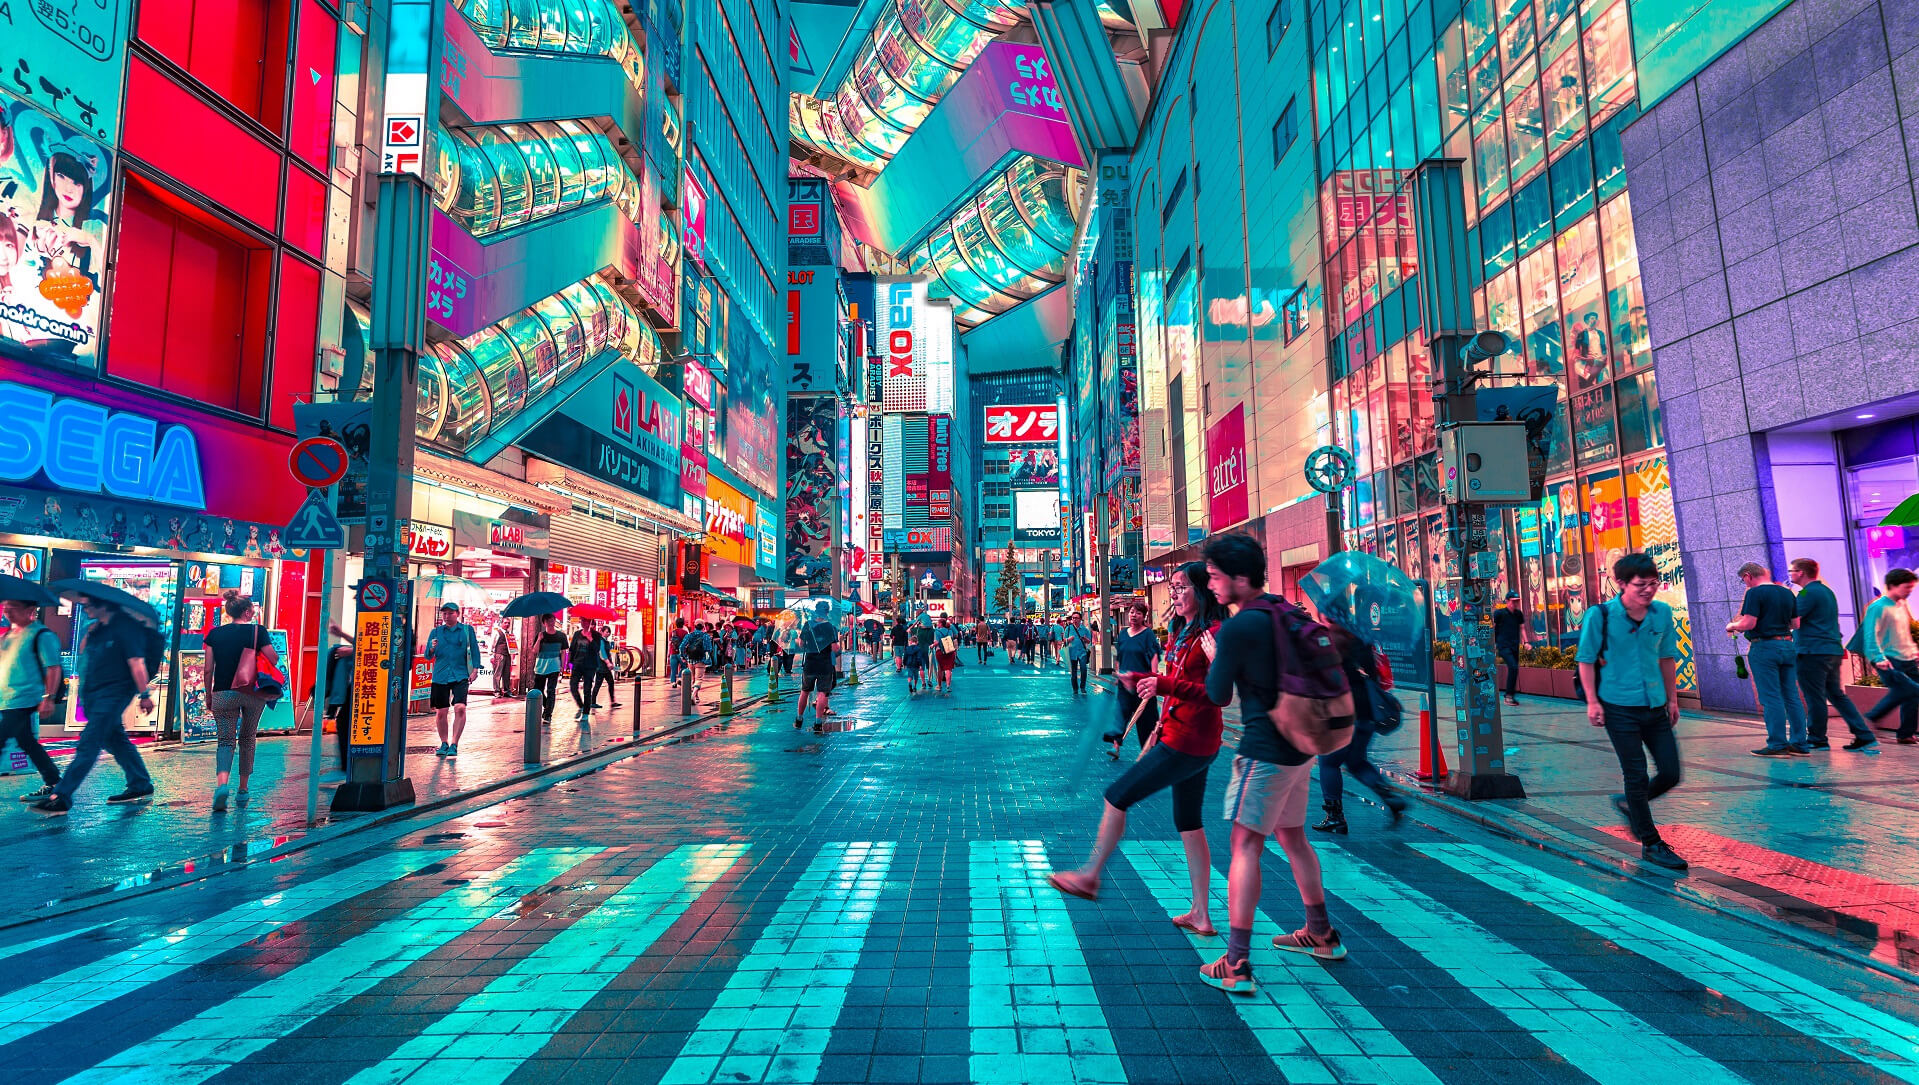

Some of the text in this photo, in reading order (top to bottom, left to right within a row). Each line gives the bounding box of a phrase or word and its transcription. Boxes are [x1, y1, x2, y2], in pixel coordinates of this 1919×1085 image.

[430, 259, 467, 299] カメラ
[428, 290, 454, 318] メラ
[637, 389, 679, 450] LABI
[0, 380, 206, 510] SEGA
[598, 443, 650, 492] パソコン館
[636, 434, 679, 470] AKIHABARA
[935, 417, 949, 472] Duty Free
[1212, 447, 1239, 495] atré
[502, 525, 524, 544] LABI
[1026, 529, 1055, 537] TOKYO
[360, 620, 380, 742] 路上喫煙禁止です。
